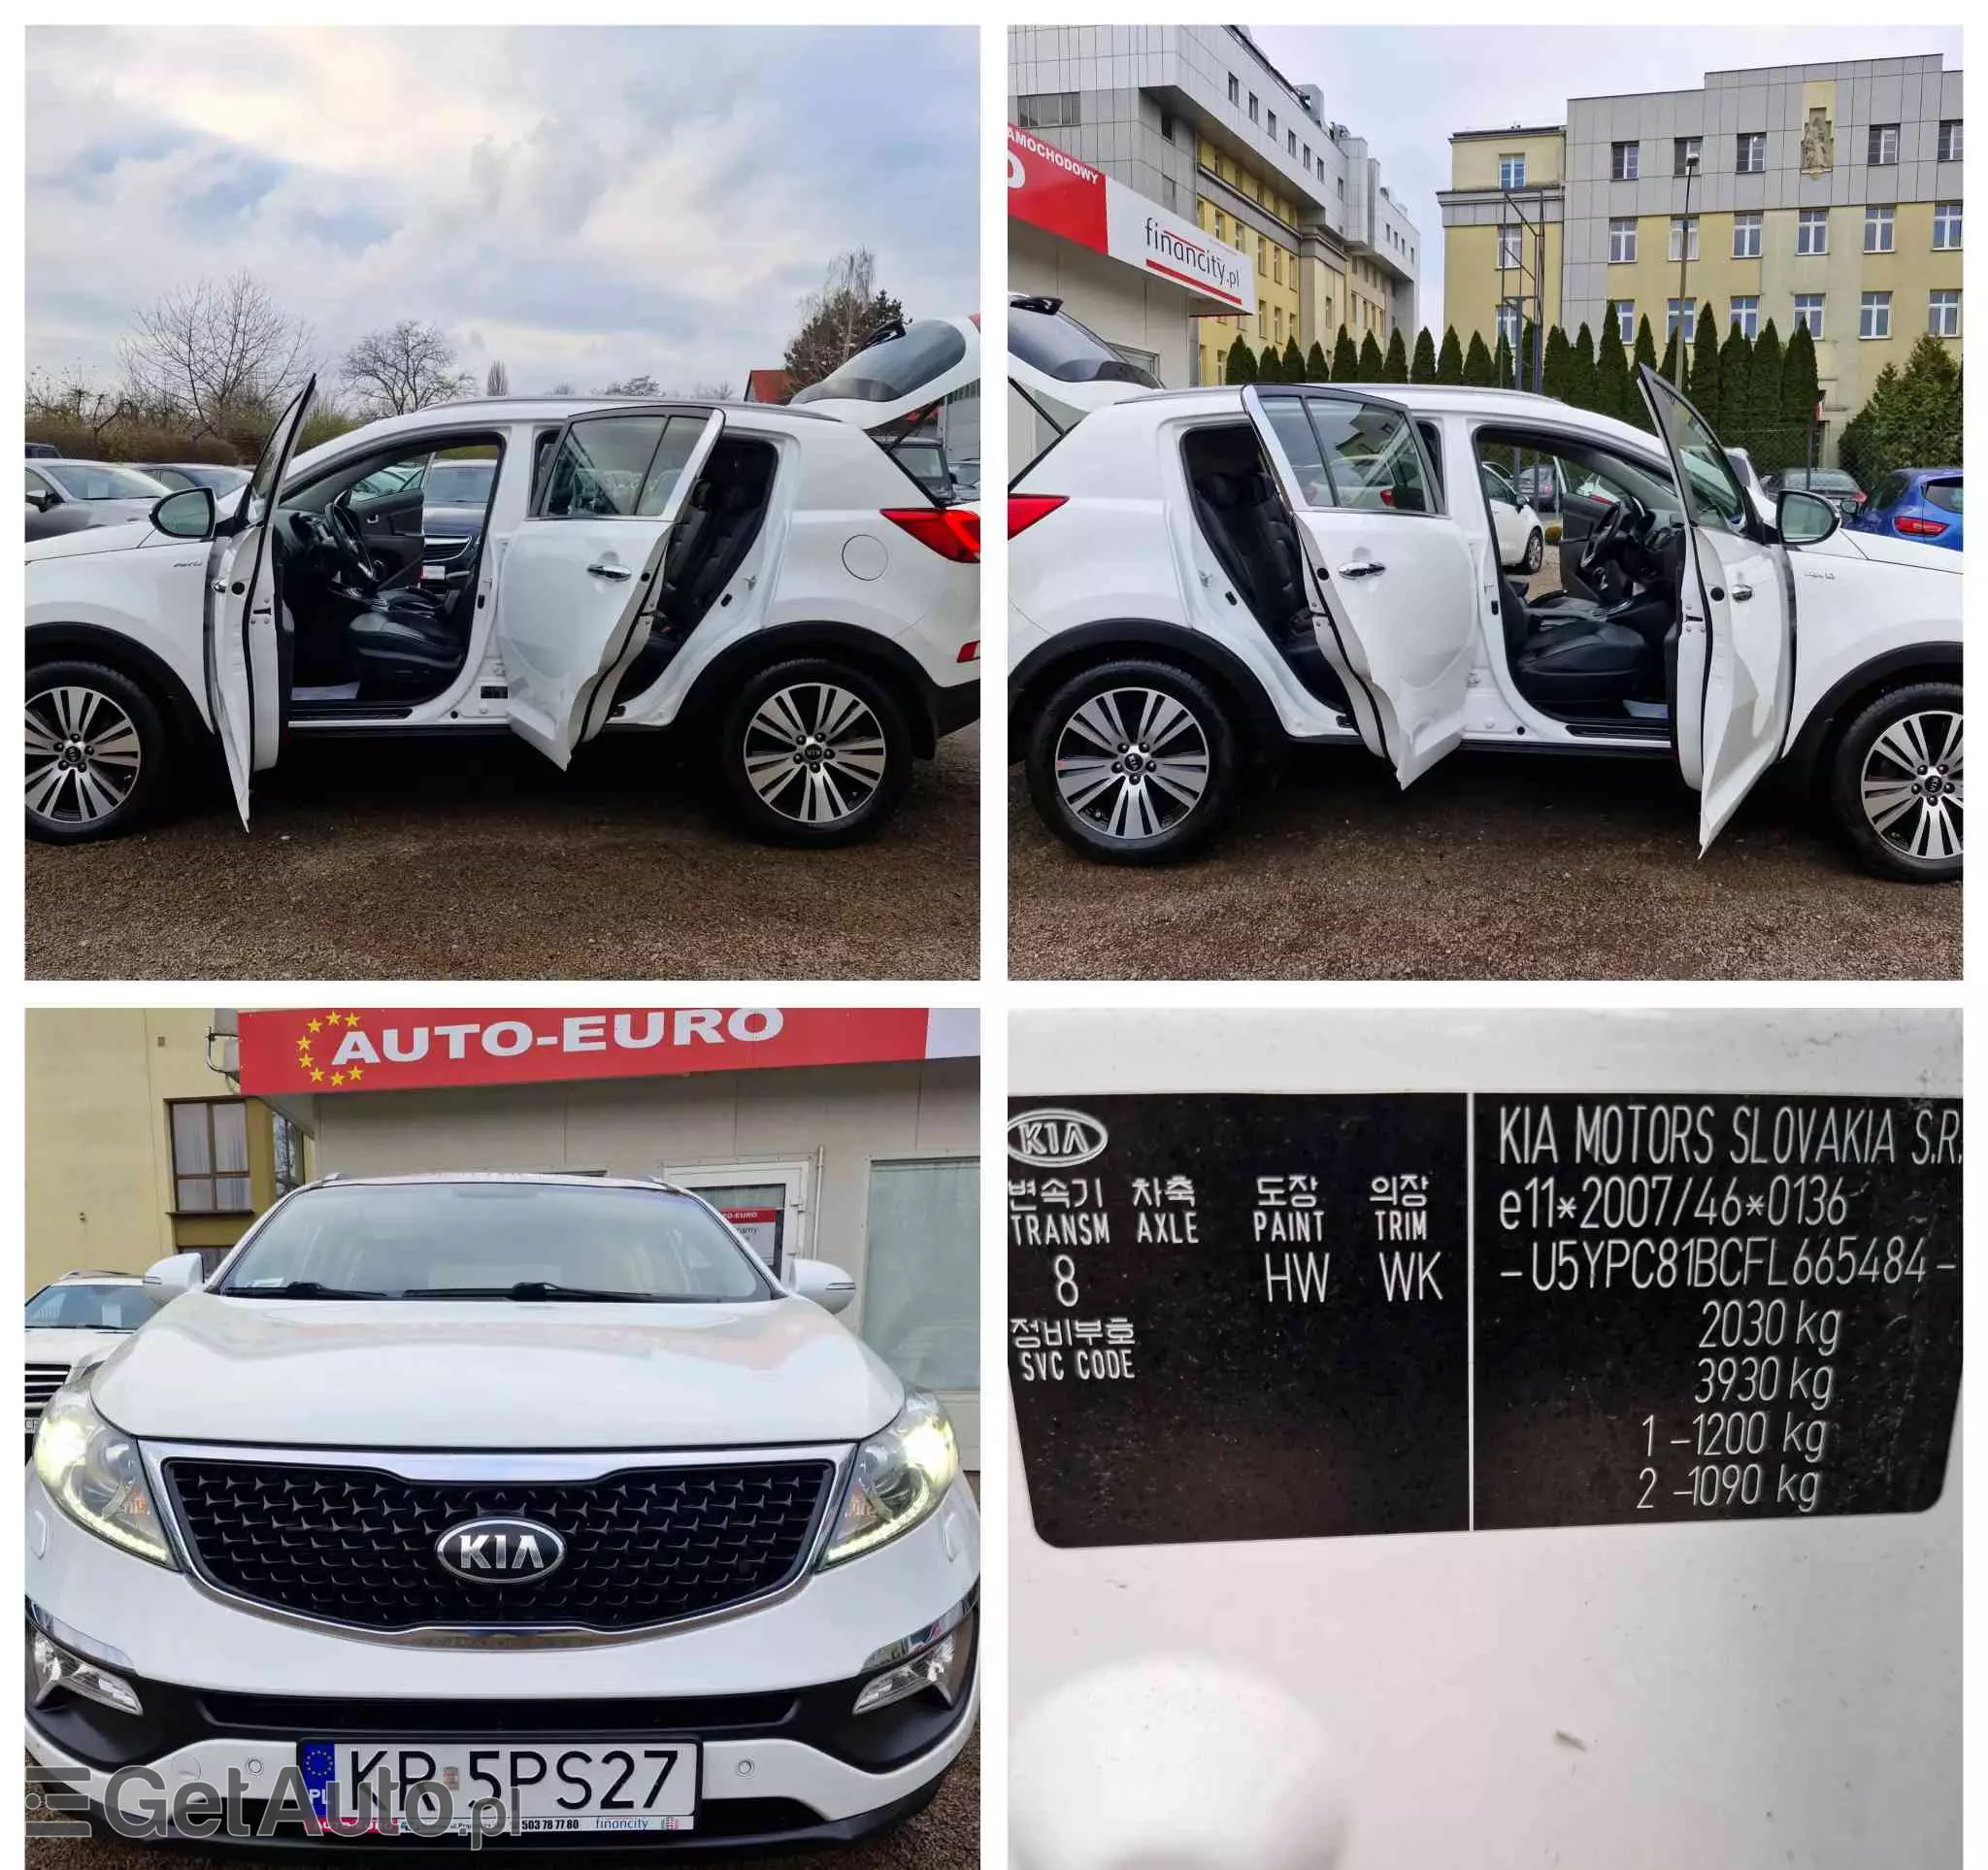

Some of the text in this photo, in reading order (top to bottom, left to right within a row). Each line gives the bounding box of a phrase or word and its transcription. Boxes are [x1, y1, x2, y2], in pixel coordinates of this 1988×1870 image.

[1144, 217, 1241, 288] financity.pl
[331, 1009, 784, 1065] AUTO-EURO
[1018, 1122, 1090, 1154] KIA
[1500, 1105, 1558, 1164] KIA
[1575, 1105, 1714, 1165] MOTORS
[1730, 1106, 1895, 1164] SLOVAKIA
[1008, 1174, 1429, 1212] 변속기 차축 도장 의장
[1011, 1210, 1427, 1246] TRANSM AXLE PAINT TRIM
[1053, 1251, 1443, 1307] 8 HW WK
[1010, 1317, 1136, 1349] 정비부호
[1698, 1298, 1841, 1356] 2030 kg
[1020, 1349, 1136, 1382] SVC CODE
[1694, 1355, 1834, 1411] 3930 kg
[1641, 1414, 1654, 1457] 1
[1782, 1411, 1827, 1463] kg
[1636, 1467, 1657, 1509] 2
[1776, 1464, 1820, 1513] kg
[459, 1534, 545, 1569] KIA
[350, 1750, 679, 1812] KR 5PS27
[522, 1820, 540, 1829] 503
[543, 1820, 552, 1829] 78
[555, 1819, 565, 1829] 77
[567, 1819, 579, 1829] 80
[595, 1818, 648, 1829] financity
